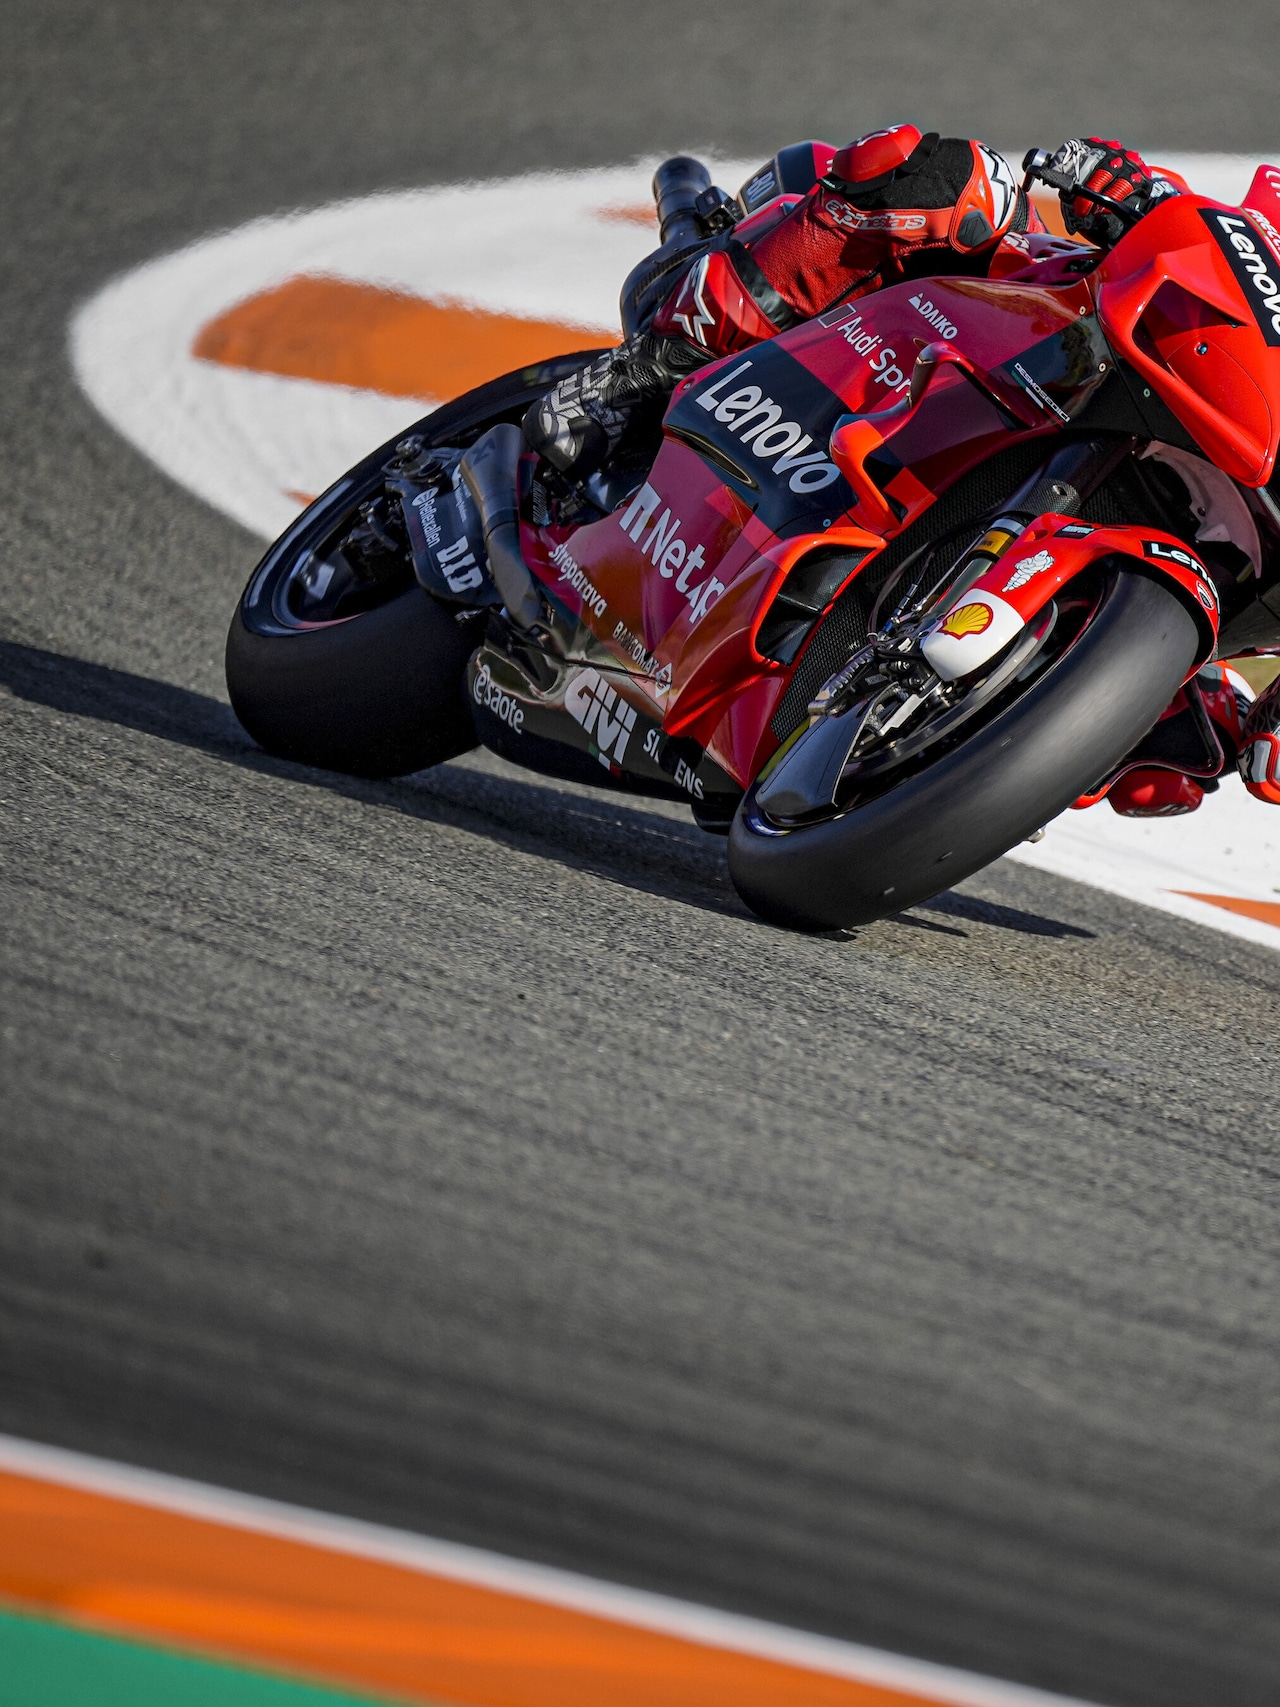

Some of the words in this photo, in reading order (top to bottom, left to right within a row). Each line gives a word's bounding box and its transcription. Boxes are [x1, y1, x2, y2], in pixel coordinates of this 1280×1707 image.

[837, 316, 883, 357] Audi
[917, 300, 958, 340] DAIKO
[694, 360, 841, 494] Lenovo
[1014, 362, 1071, 423] DESMOSEDICI
[418, 497, 441, 549] Reflexallen
[548, 543, 608, 619] streparava
[1151, 543, 1219, 612] Leno
[564, 667, 638, 765] GIVI
[643, 728, 704, 800] SIENS
